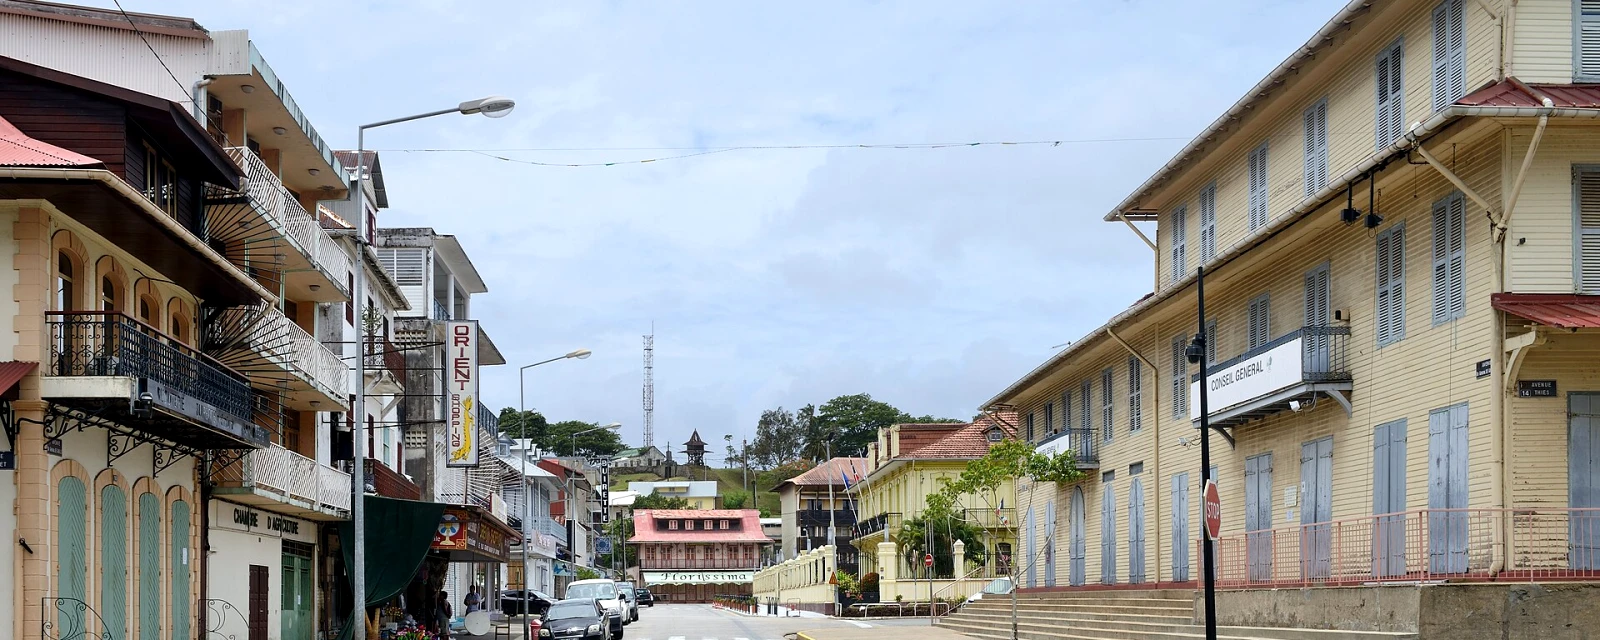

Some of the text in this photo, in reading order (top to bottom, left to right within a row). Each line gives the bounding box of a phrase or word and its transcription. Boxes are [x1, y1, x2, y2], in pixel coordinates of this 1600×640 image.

[454, 325, 470, 390] ORIENT
[1211, 360, 1264, 391] CONSEIL GENERAL
[451, 393, 460, 447] SHOPPING
[234, 507, 258, 527] CHAMBRE
[1207, 501, 1219, 519] STOP
[661, 572, 747, 581] Florissima
